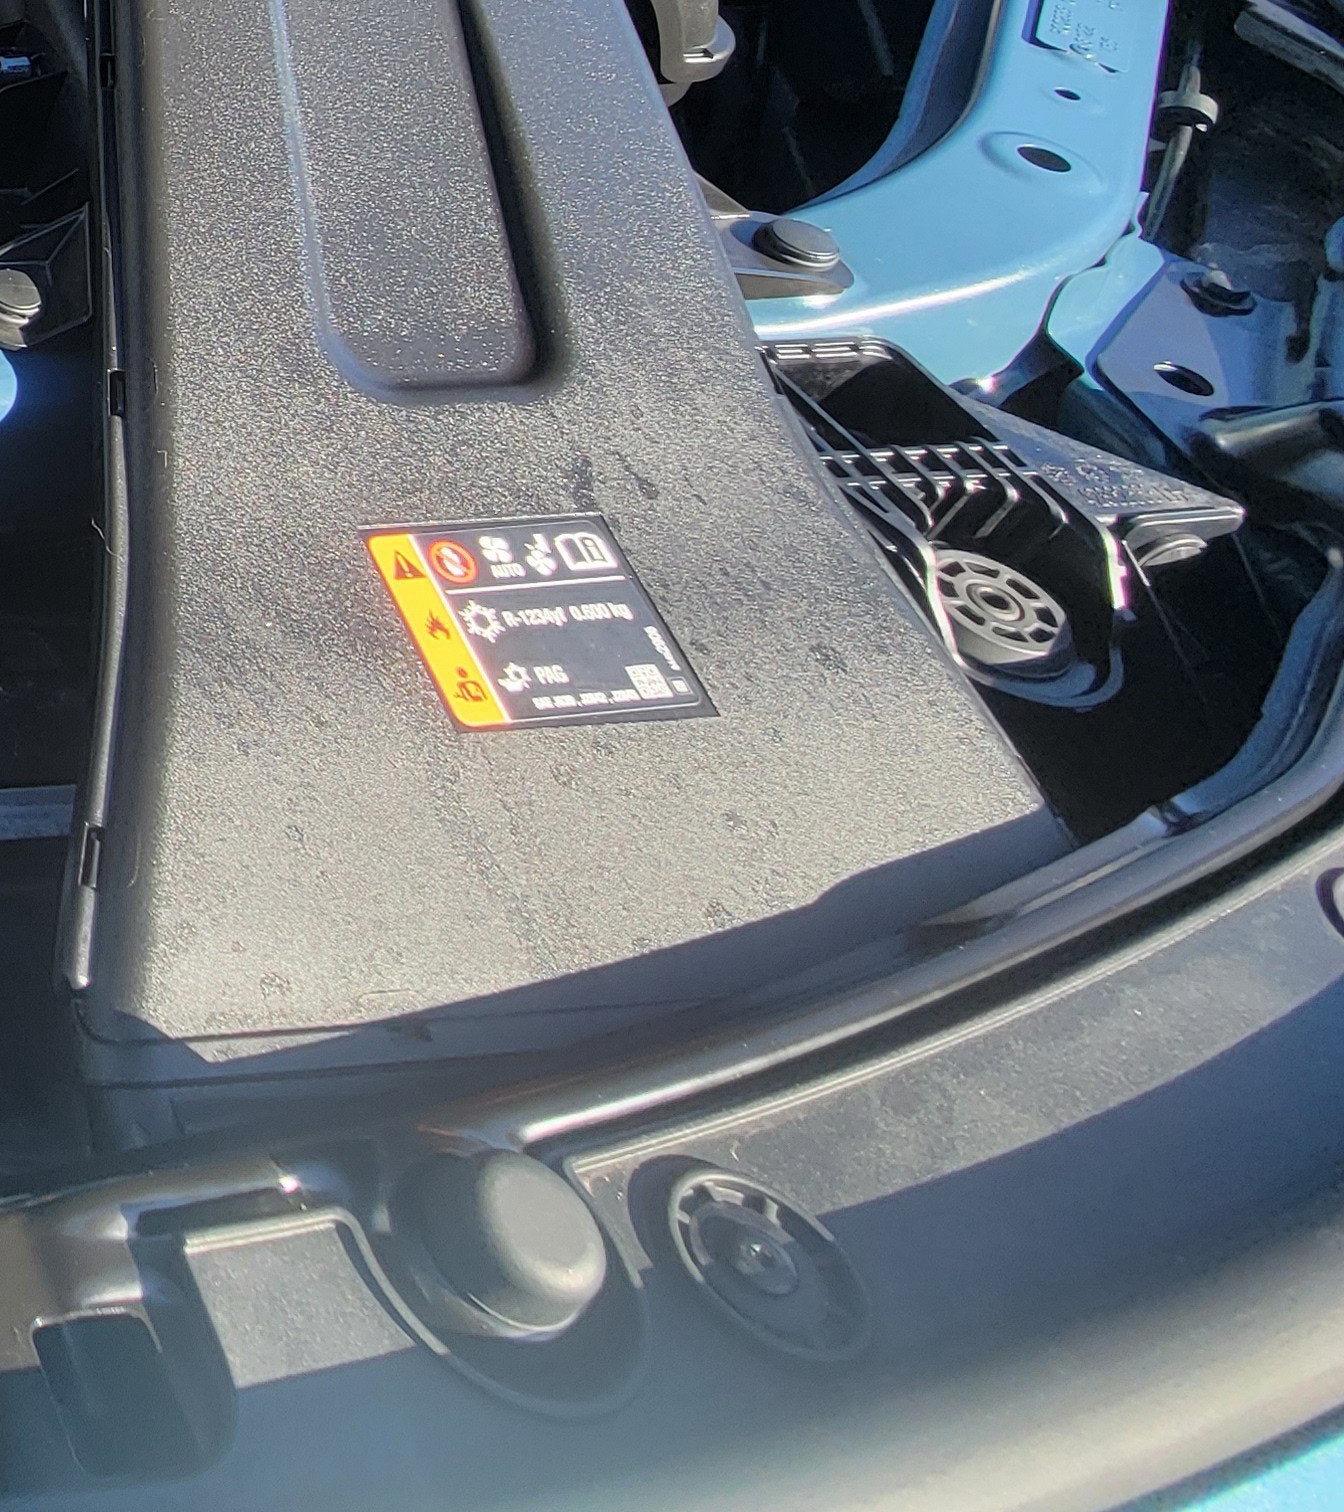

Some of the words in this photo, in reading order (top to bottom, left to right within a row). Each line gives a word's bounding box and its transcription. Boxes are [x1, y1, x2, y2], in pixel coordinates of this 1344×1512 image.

[490, 562, 527, 579] AUTO
[501, 605, 568, 627] R-1234yf
[609, 601, 635, 621] kg
[533, 664, 570, 685] PAG
